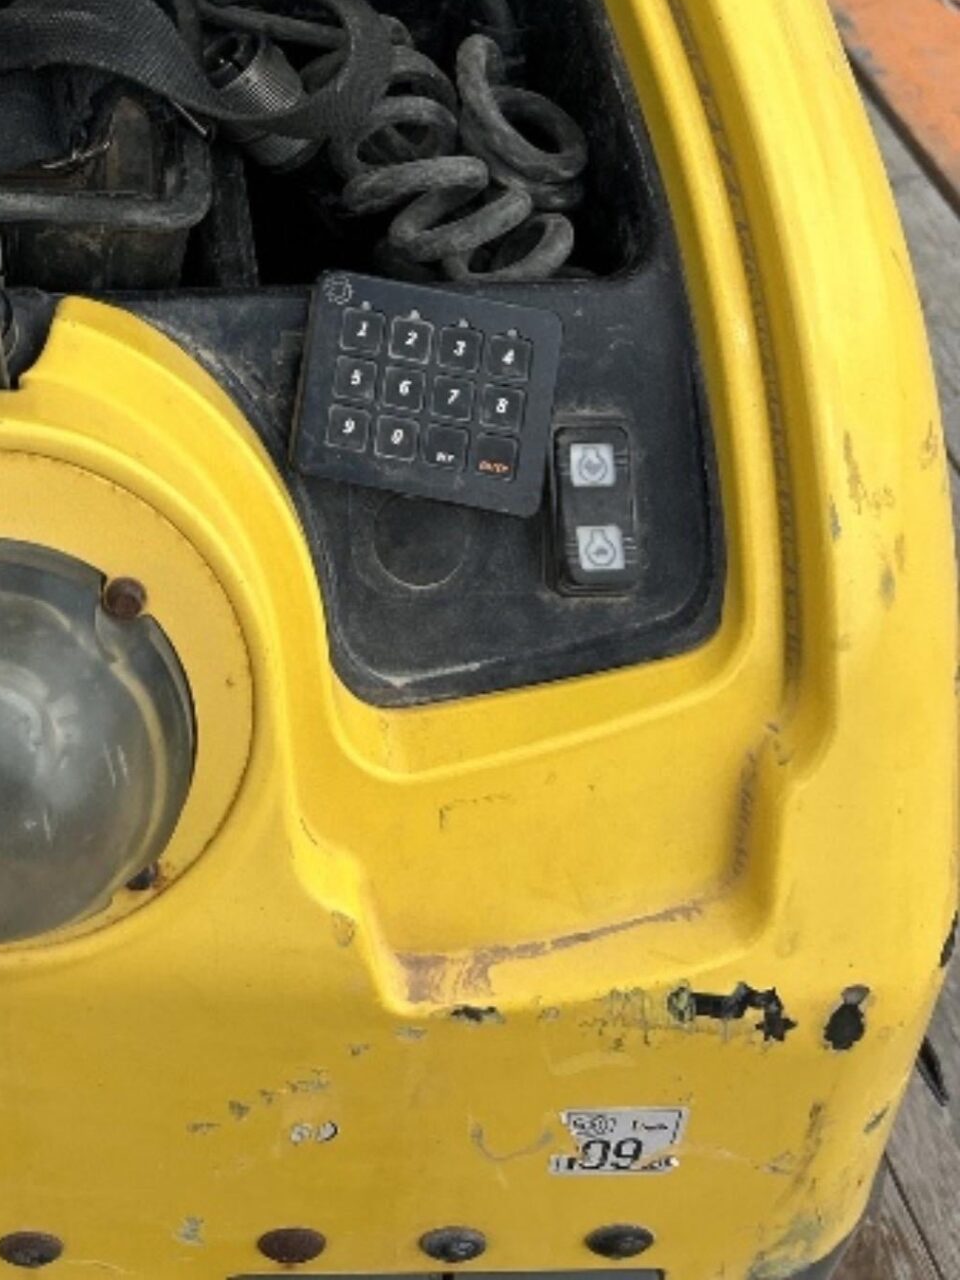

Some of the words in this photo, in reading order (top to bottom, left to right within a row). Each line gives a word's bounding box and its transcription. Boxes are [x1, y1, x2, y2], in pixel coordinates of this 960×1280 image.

[357, 321, 368, 337] 1
[405, 330, 418, 346] 2
[453, 340, 467, 357] 3
[502, 349, 515, 365] 4
[350, 370, 362, 385] 5
[399, 380, 412, 396] 6
[447, 389, 460, 405] 7
[496, 398, 509, 414] 8
[342, 417, 356, 434] 9
